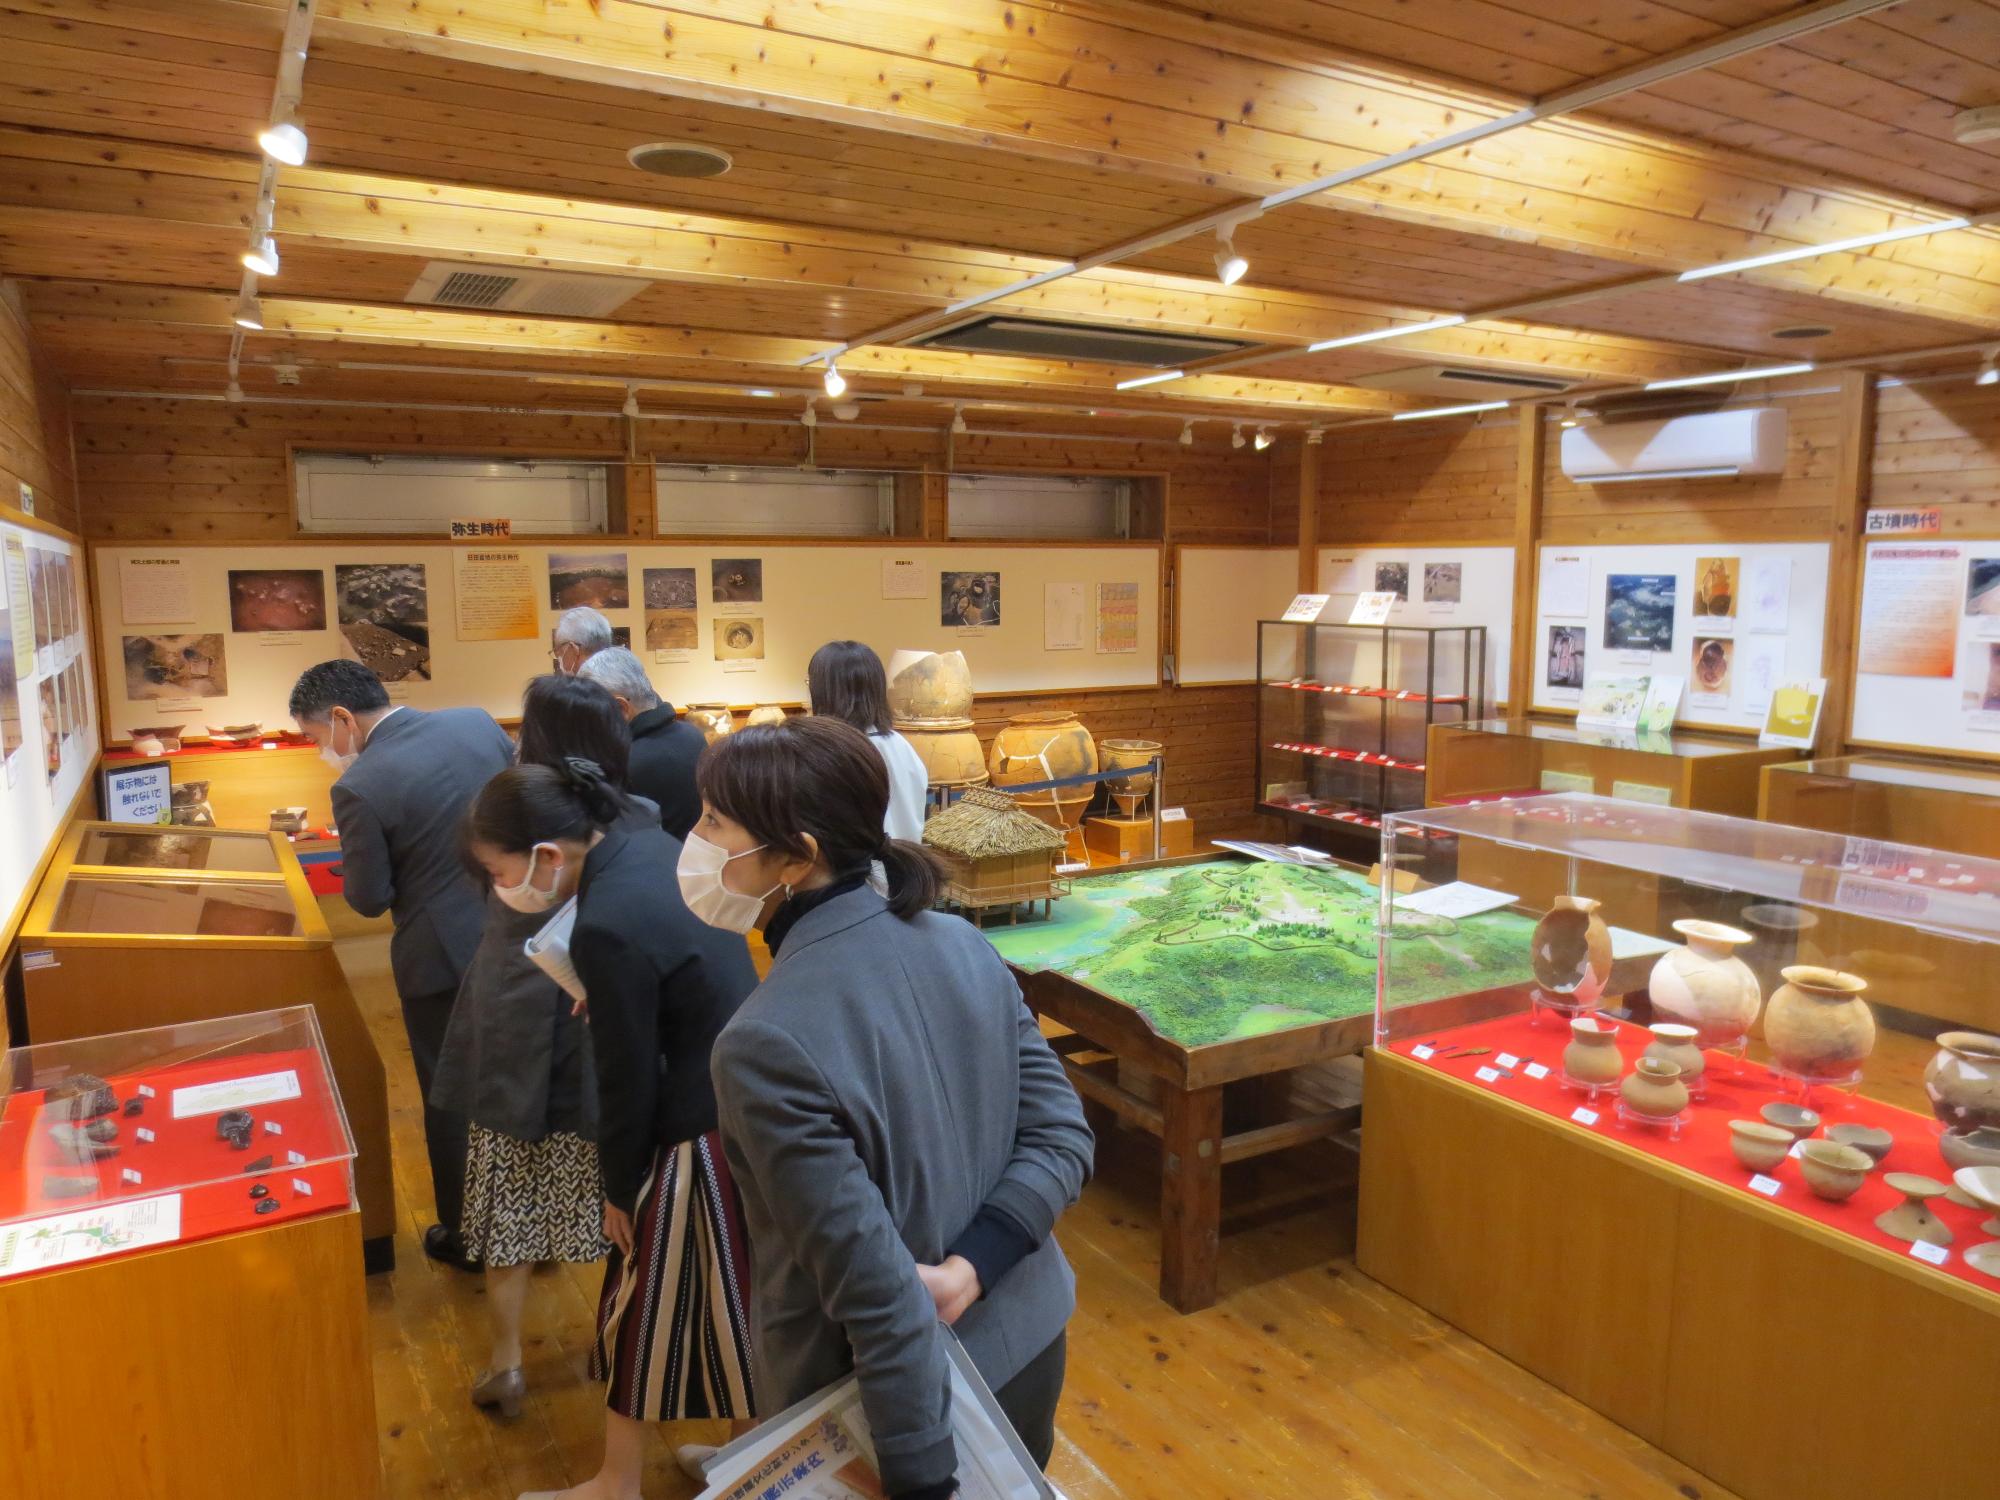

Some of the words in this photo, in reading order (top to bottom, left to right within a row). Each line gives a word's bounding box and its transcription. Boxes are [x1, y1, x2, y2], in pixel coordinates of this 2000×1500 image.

[451, 521, 509, 537] 弥生時代
[1868, 512, 1937, 530] 古墳時代
[115, 774, 158, 792] 展示物には
[122, 788, 162, 806] 触れないで
[754, 1449, 826, 1500] 展示案内
